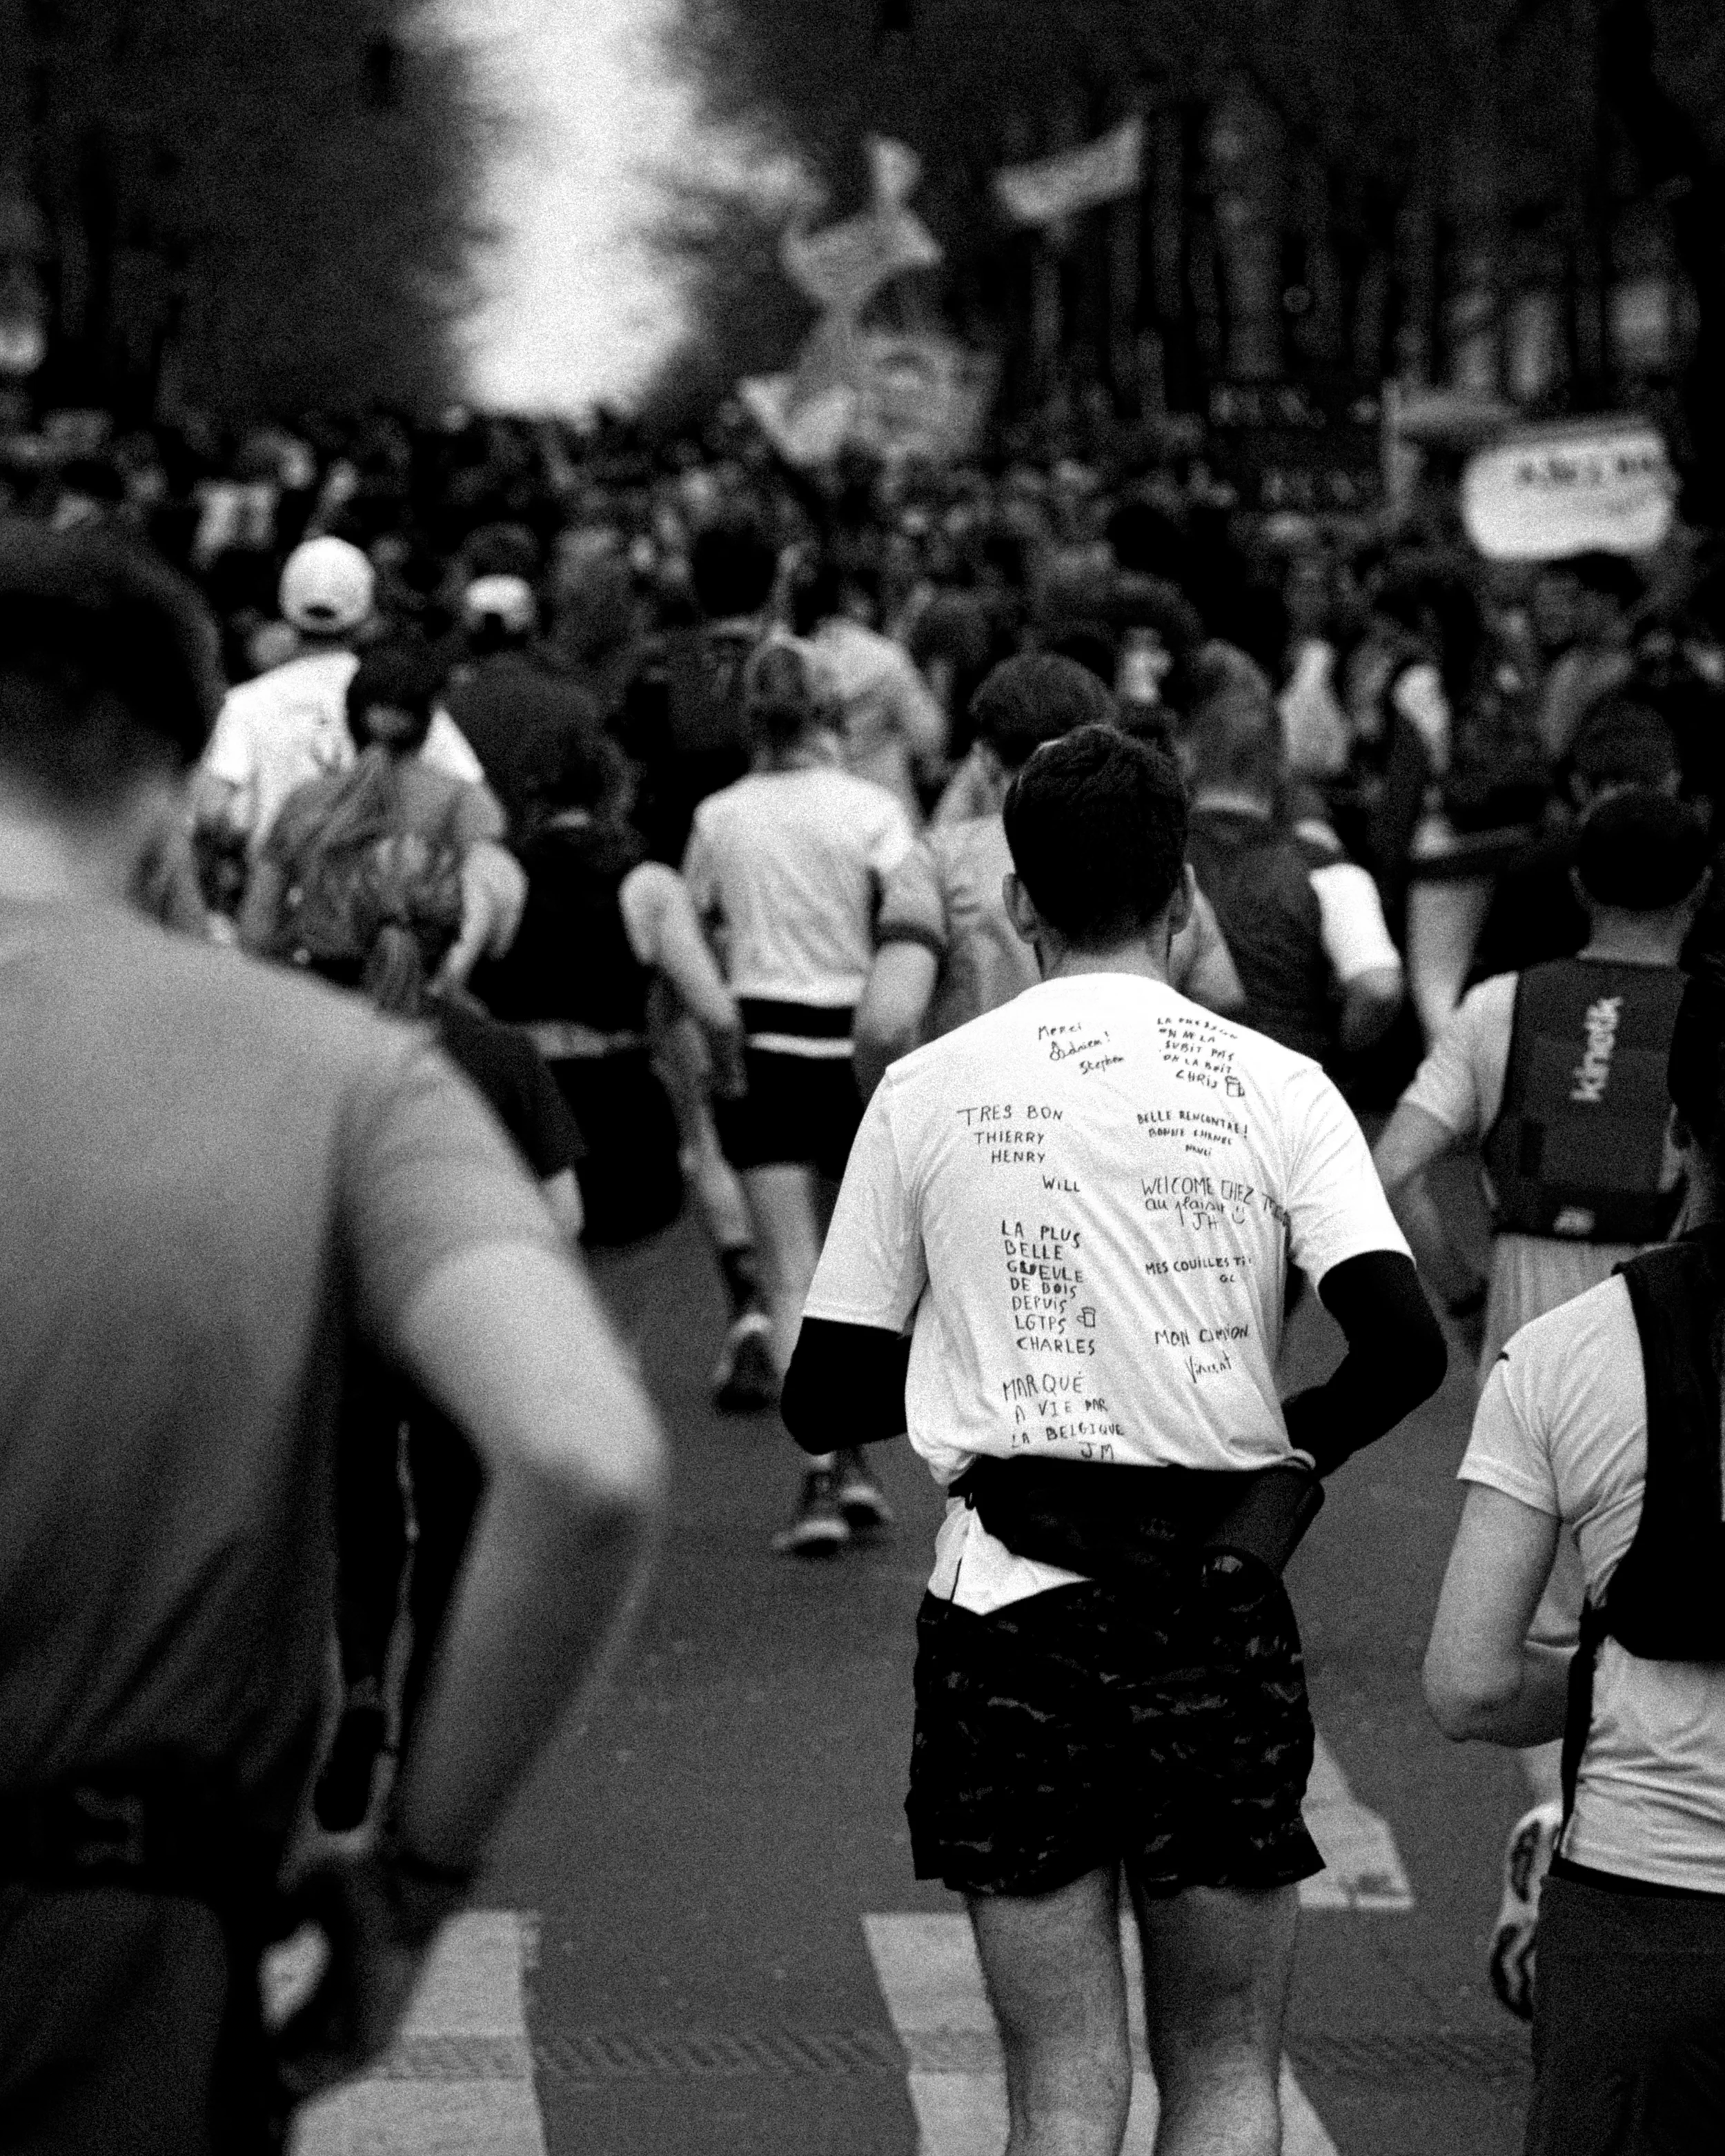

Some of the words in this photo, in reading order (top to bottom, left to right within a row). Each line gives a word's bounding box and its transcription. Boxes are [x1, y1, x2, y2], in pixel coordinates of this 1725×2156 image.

[1163, 1054, 1179, 1062] ON
[956, 1105, 1012, 1126] TRES
[1027, 1105, 1063, 1120] BON
[1137, 1110, 1171, 1125] BELLE
[974, 1131, 1045, 1145] THIERRY
[1149, 1127, 1185, 1138] BONNE
[992, 1149, 1045, 1163] HENRY
[1141, 1176, 1213, 1196] WELCOME
[1221, 1180, 1254, 1205] CHEZ
[1145, 1198, 1168, 1211] au
[1002, 1220, 1023, 1238] LA
[1041, 1225, 1081, 1249] PLUS
[1005, 1240, 1064, 1260] BELLE
[1145, 1261, 1168, 1275] MES
[1010, 1277, 1030, 1292] DE
[1042, 1281, 1077, 1299] BOIS
[1015, 1314, 1066, 1334] LGTPS
[1016, 1336, 1095, 1356] CHARLES
[1155, 1329, 1190, 1347] MON
[1038, 1399, 1072, 1417] VIE
[1085, 1398, 1108, 1412] PAR
[1012, 1432, 1029, 1448] LA
[1045, 1422, 1125, 1441] BELGIQUE
